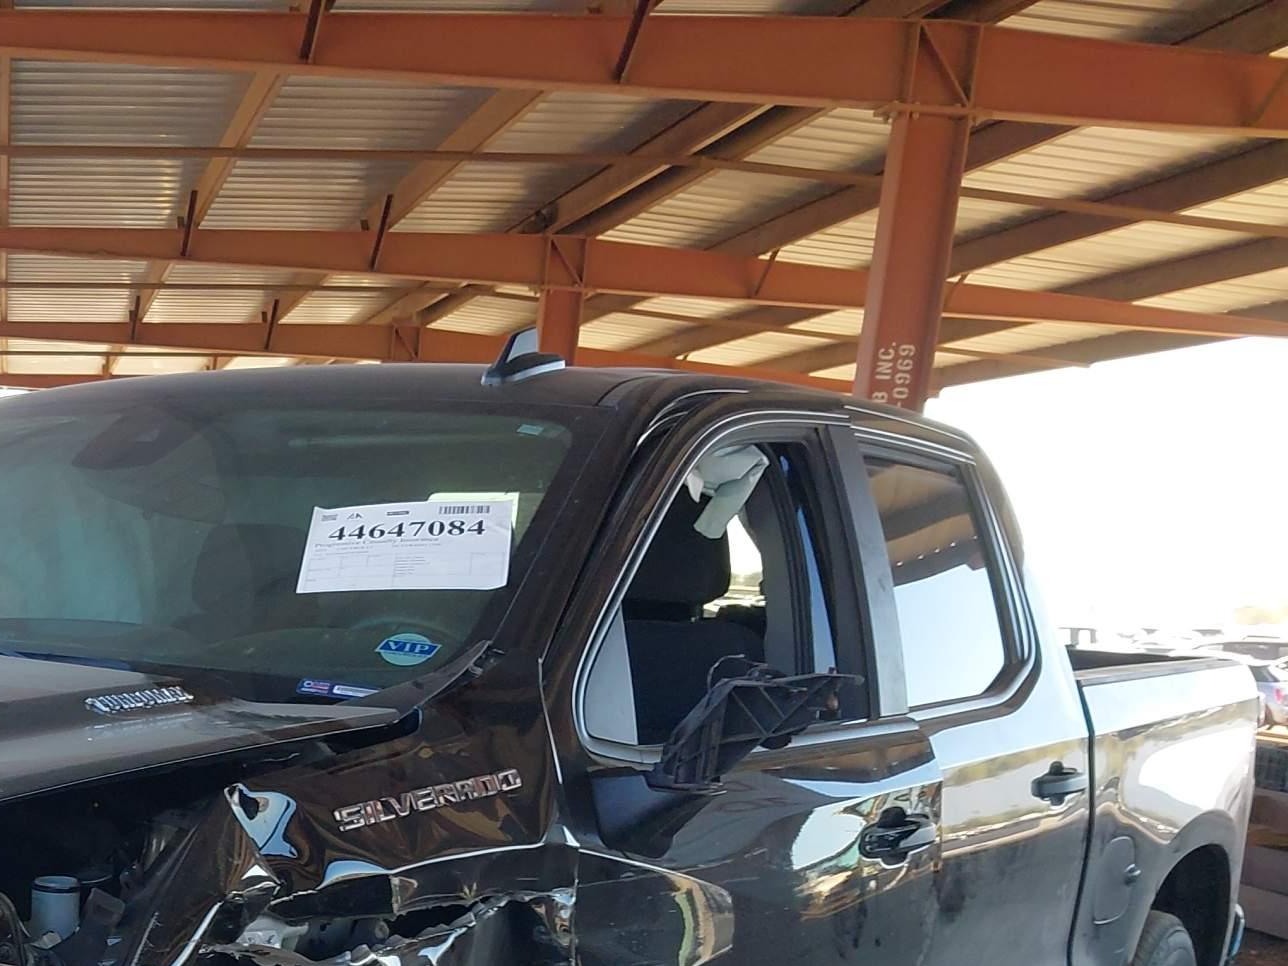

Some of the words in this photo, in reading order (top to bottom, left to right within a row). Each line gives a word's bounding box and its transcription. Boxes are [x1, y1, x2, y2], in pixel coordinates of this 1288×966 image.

[876, 342, 897, 380] INC.
[328, 520, 486, 541] 44647084
[388, 641, 430, 653] VIP
[333, 768, 523, 832] SILVERADO
